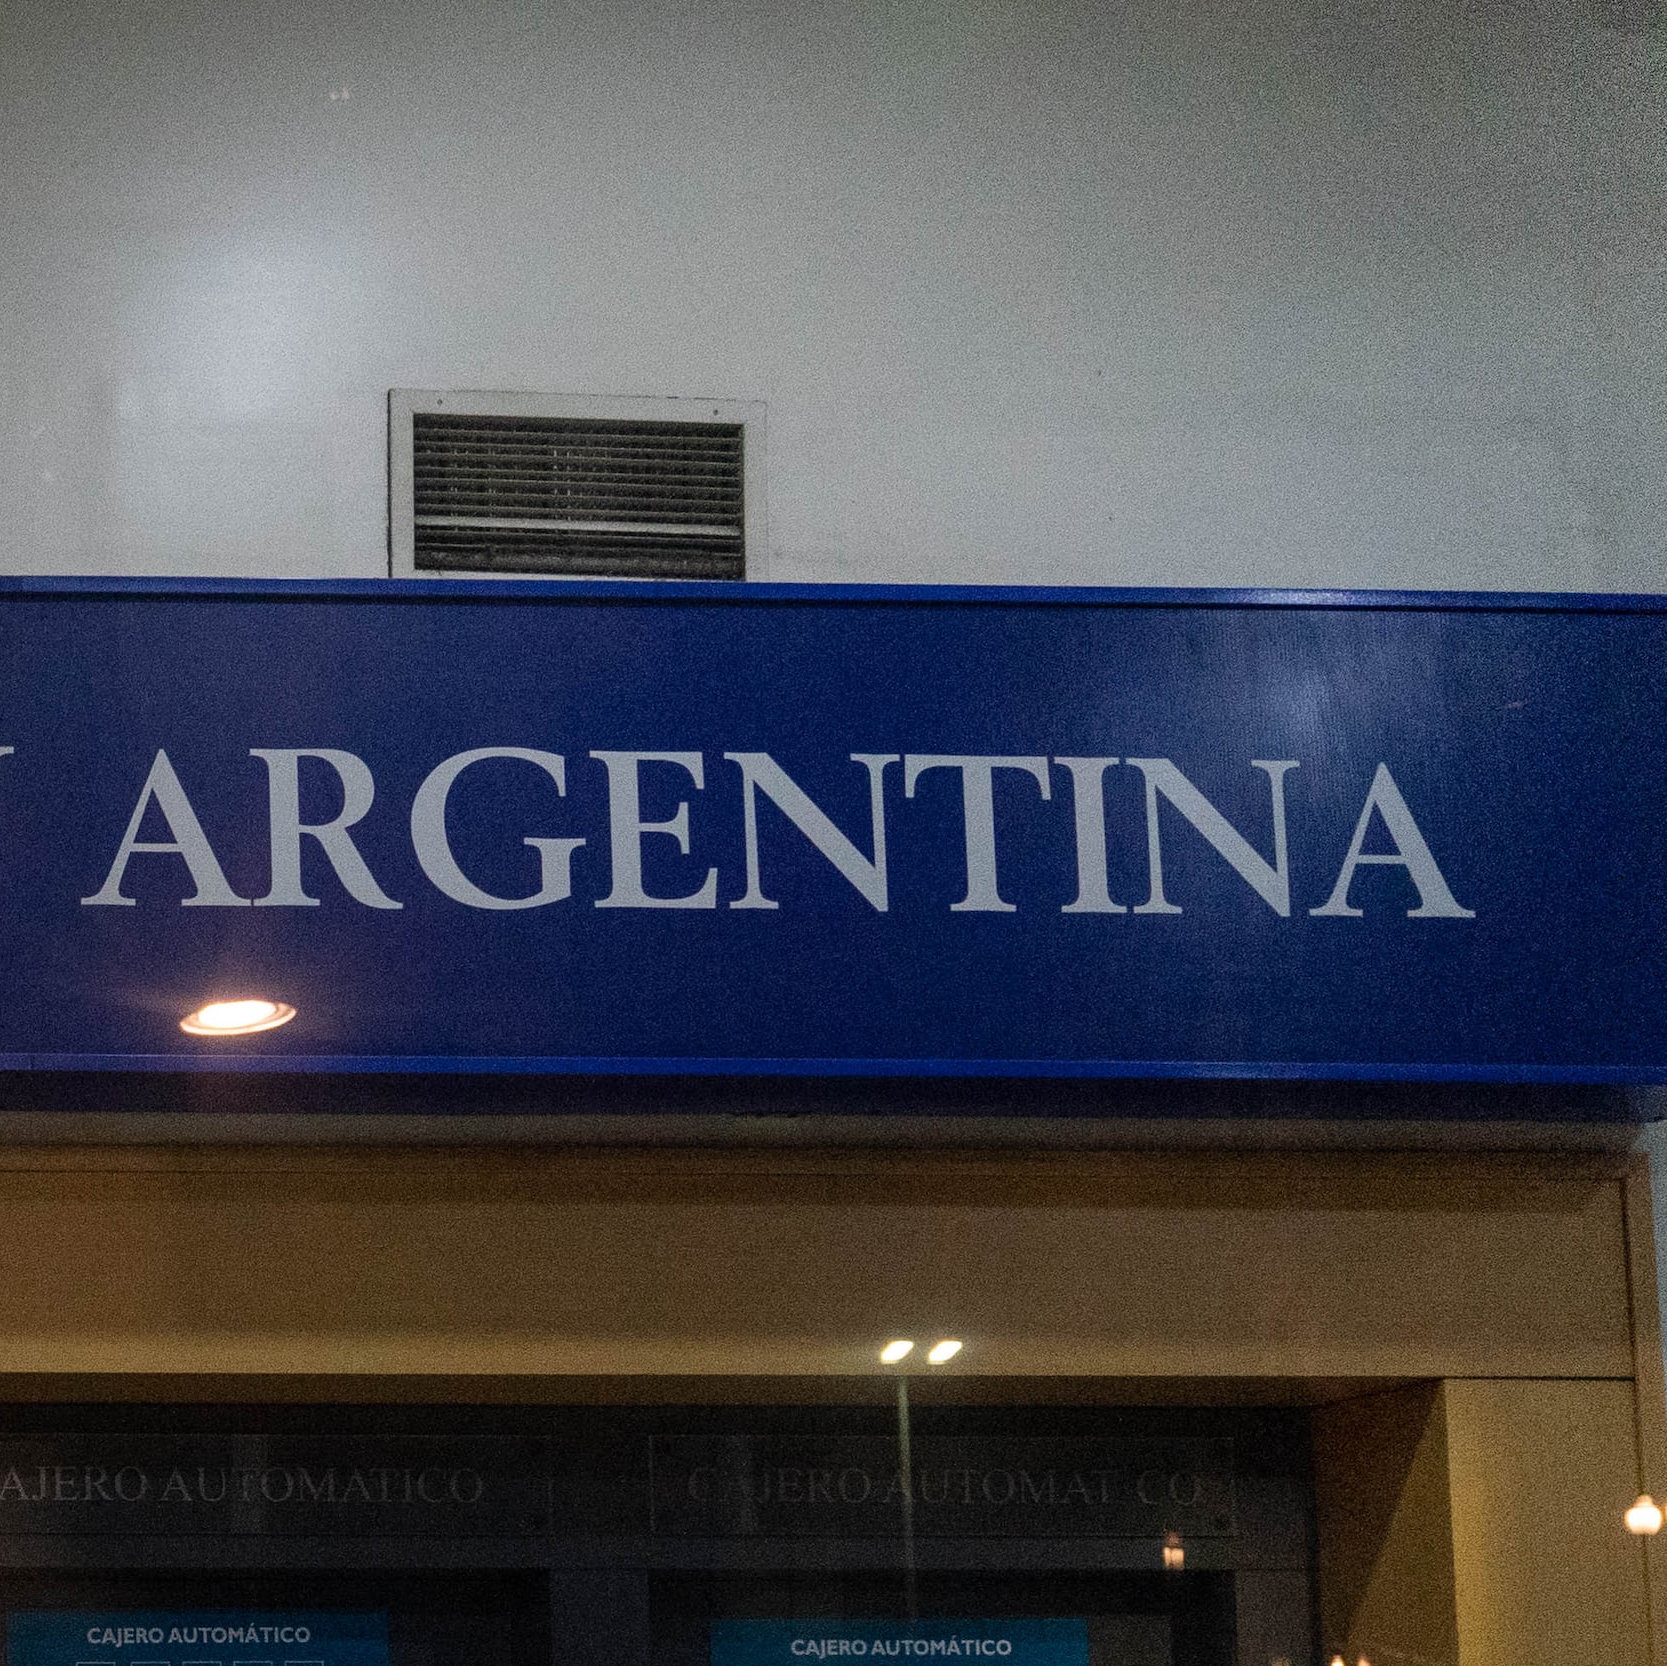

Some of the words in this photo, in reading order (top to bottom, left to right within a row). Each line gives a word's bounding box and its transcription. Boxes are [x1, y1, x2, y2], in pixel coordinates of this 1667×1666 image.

[81, 746, 1475, 917] ARGENTINA
[156, 1466, 484, 1505] AUTOMATICO
[687, 1467, 871, 1505] CAJERO
[87, 1626, 165, 1649] CAJERO
[168, 1622, 312, 1645] AUTOMÁTICO
[790, 1638, 867, 1661] CAJERO
[870, 1634, 1013, 1658] AUTOMÁTICO
